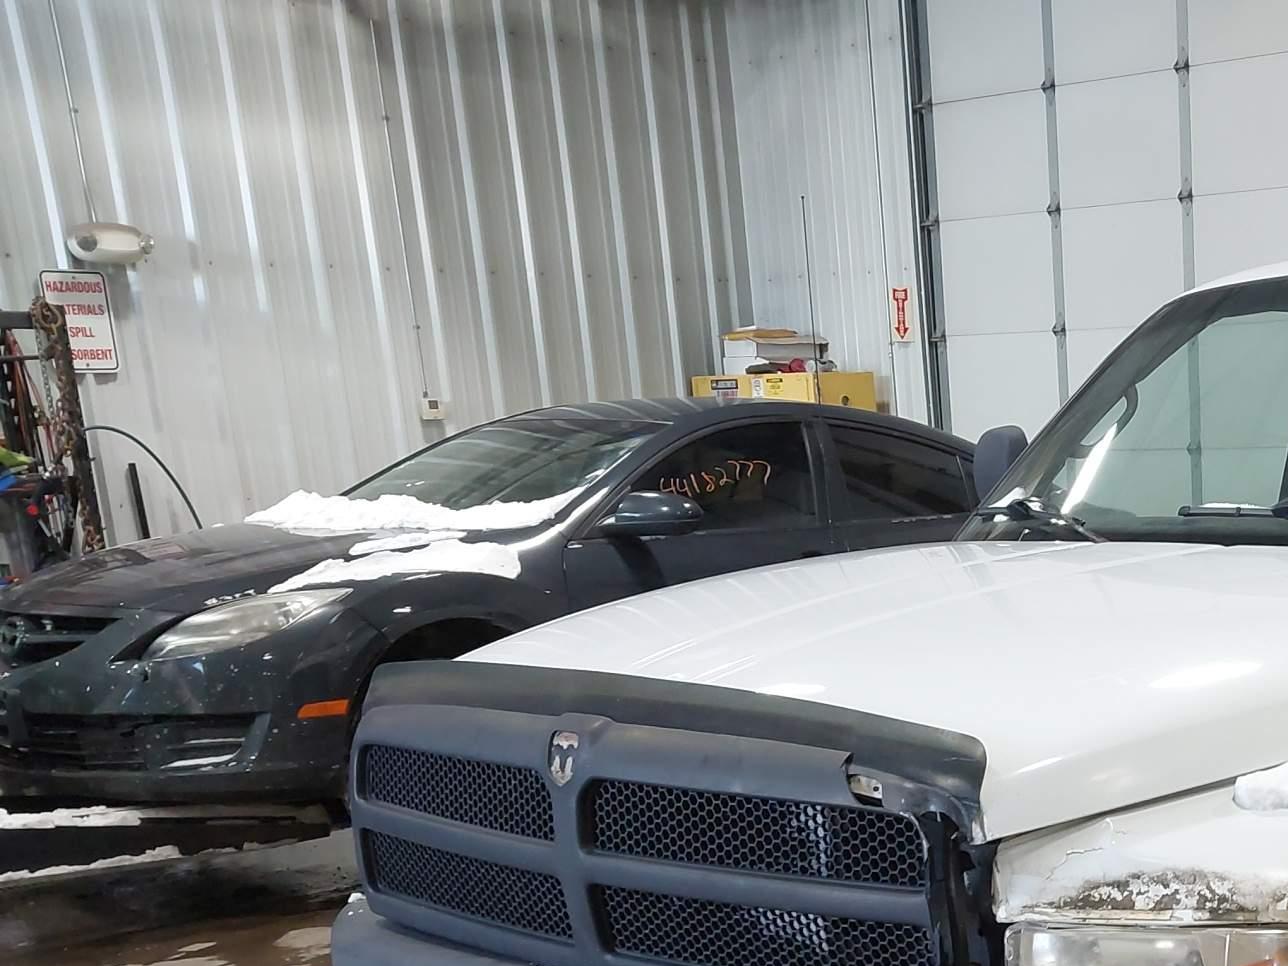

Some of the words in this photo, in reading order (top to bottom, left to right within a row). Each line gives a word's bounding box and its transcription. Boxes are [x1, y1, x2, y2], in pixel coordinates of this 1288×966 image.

[44, 280, 103, 293] HAZARDOUS
[64, 304, 105, 316] TERIALS
[68, 326, 96, 338] SPILL
[71, 349, 113, 361] SORBENT
[659, 459, 772, 498] 44182777
